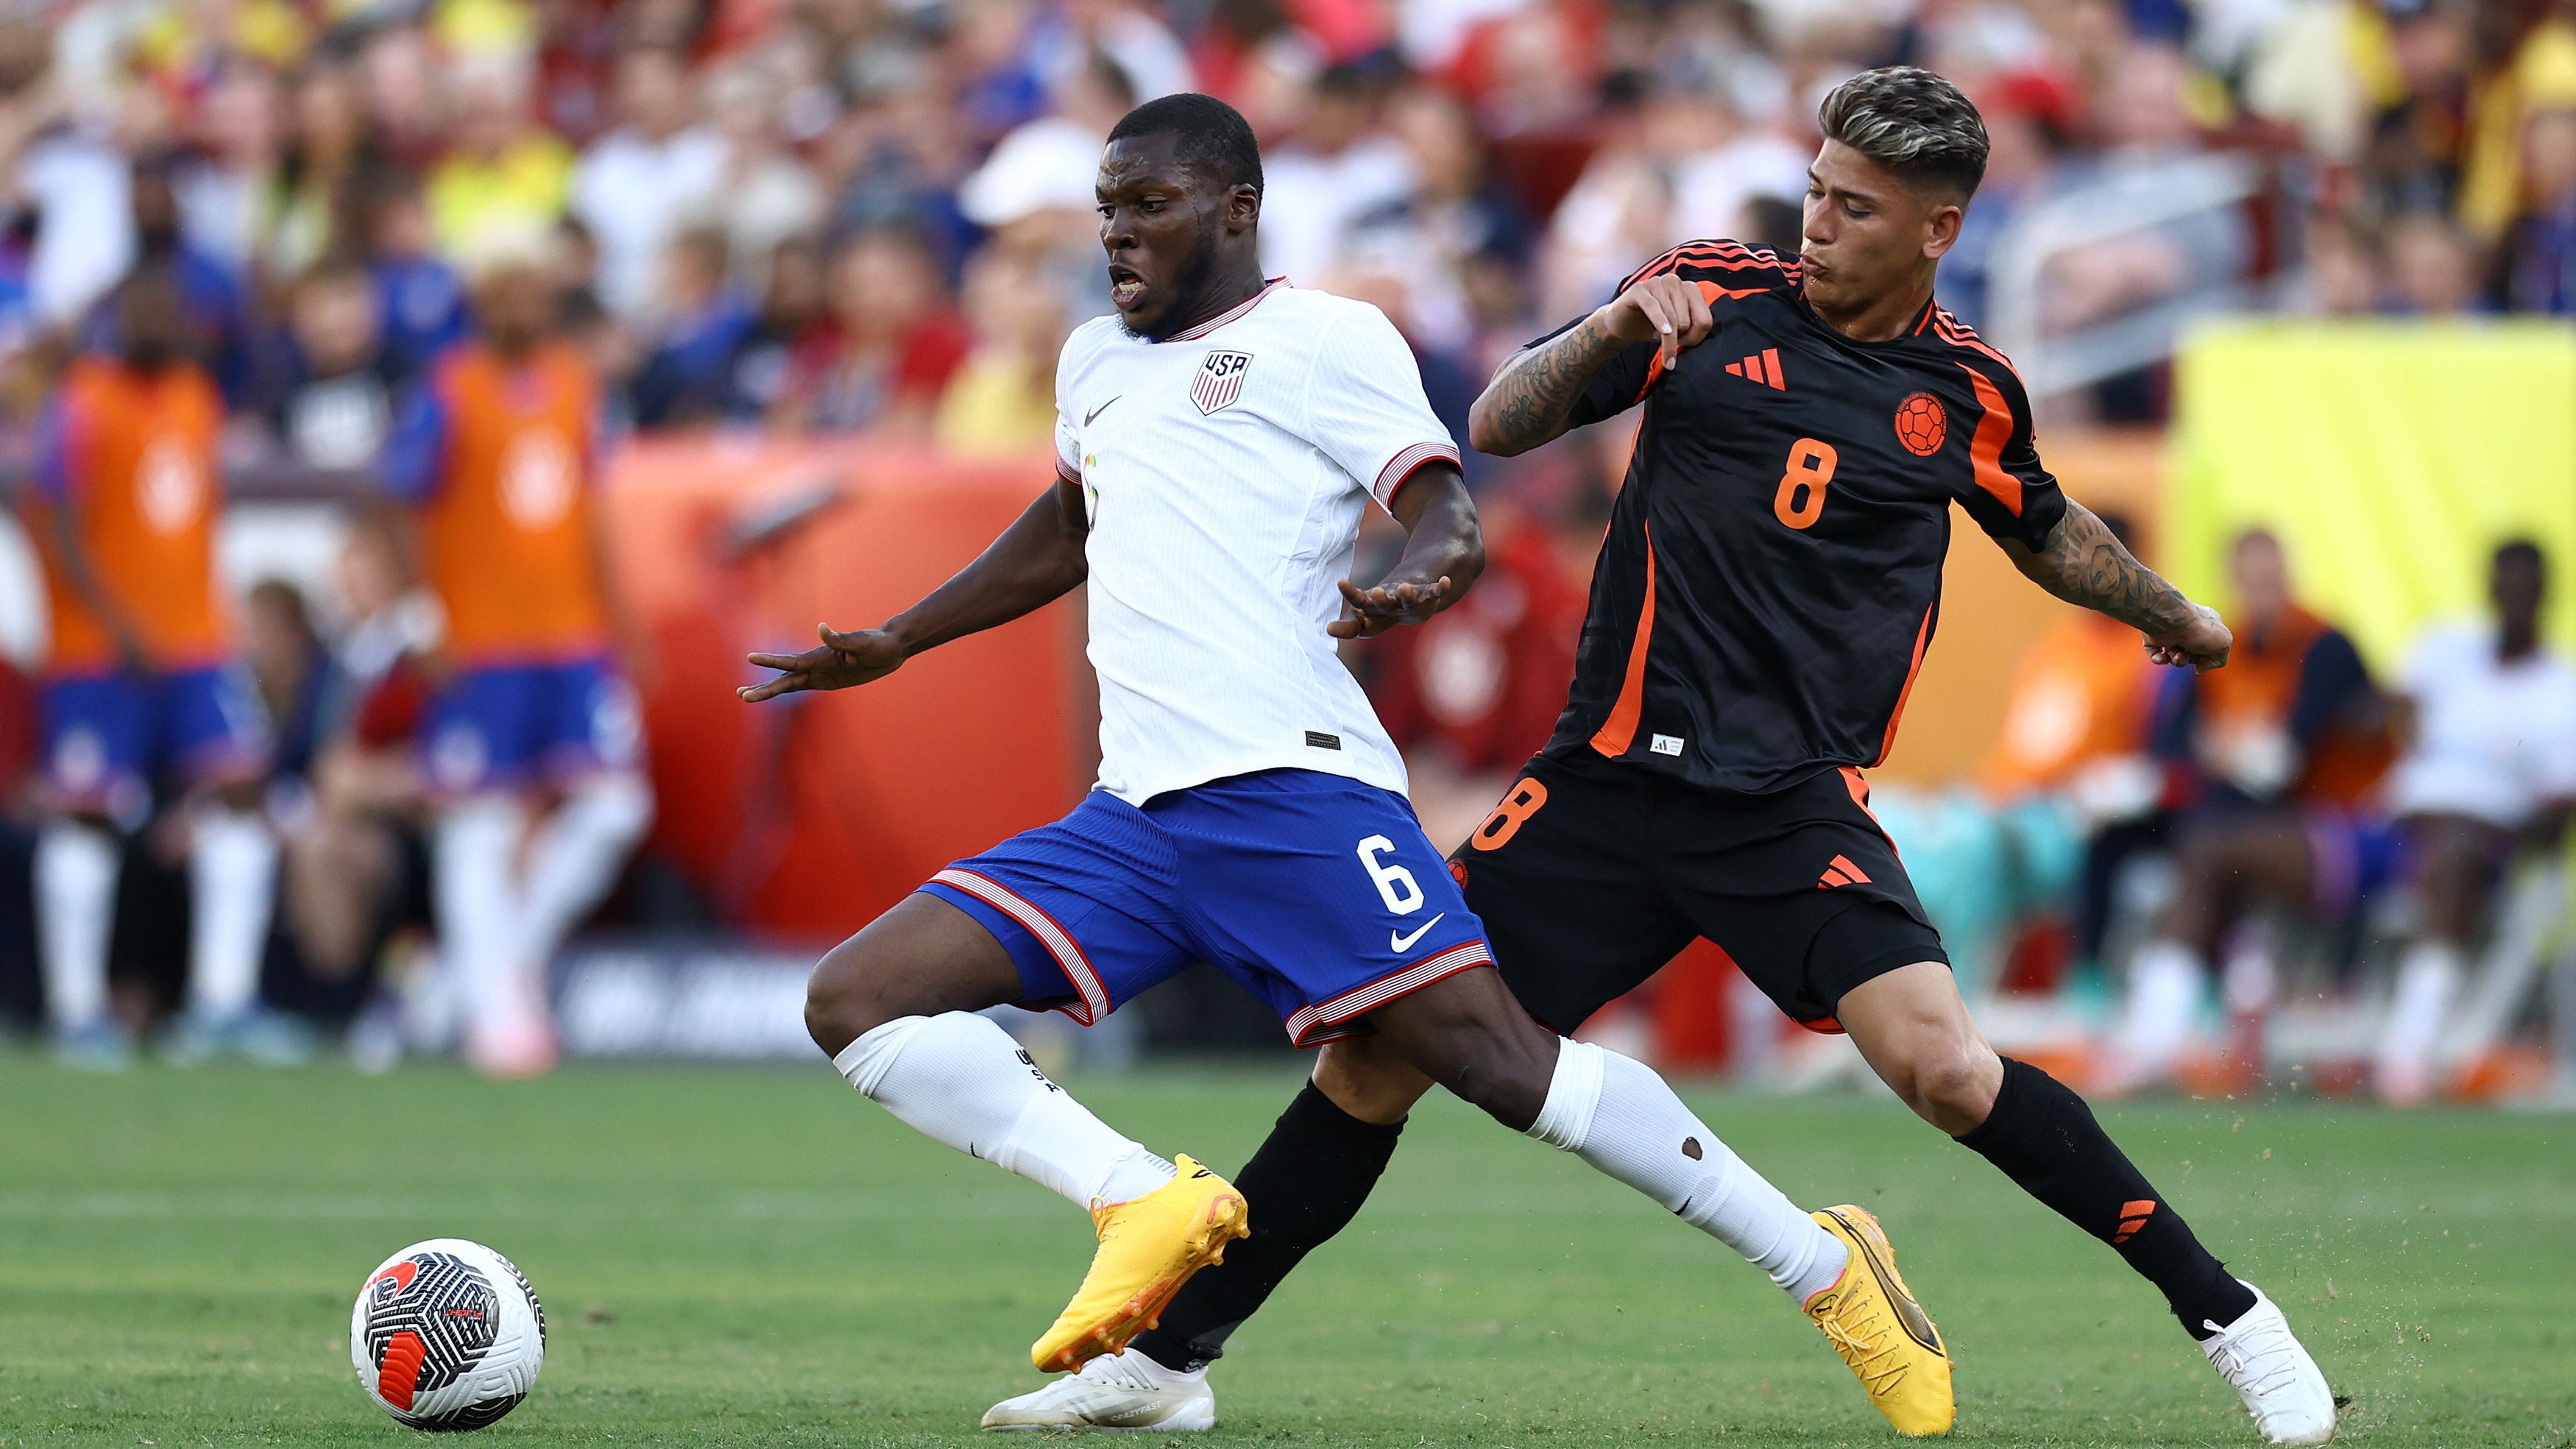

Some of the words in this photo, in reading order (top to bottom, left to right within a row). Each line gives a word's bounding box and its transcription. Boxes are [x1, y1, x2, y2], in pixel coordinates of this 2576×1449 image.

[1206, 355, 1248, 377] USA
[1774, 437, 1838, 529] 8
[1471, 777, 1548, 851] 8
[1356, 834, 1425, 915] 6
[1015, 1048, 1060, 1093] USA
[1111, 1400, 1161, 1421] CRAZYFAST
